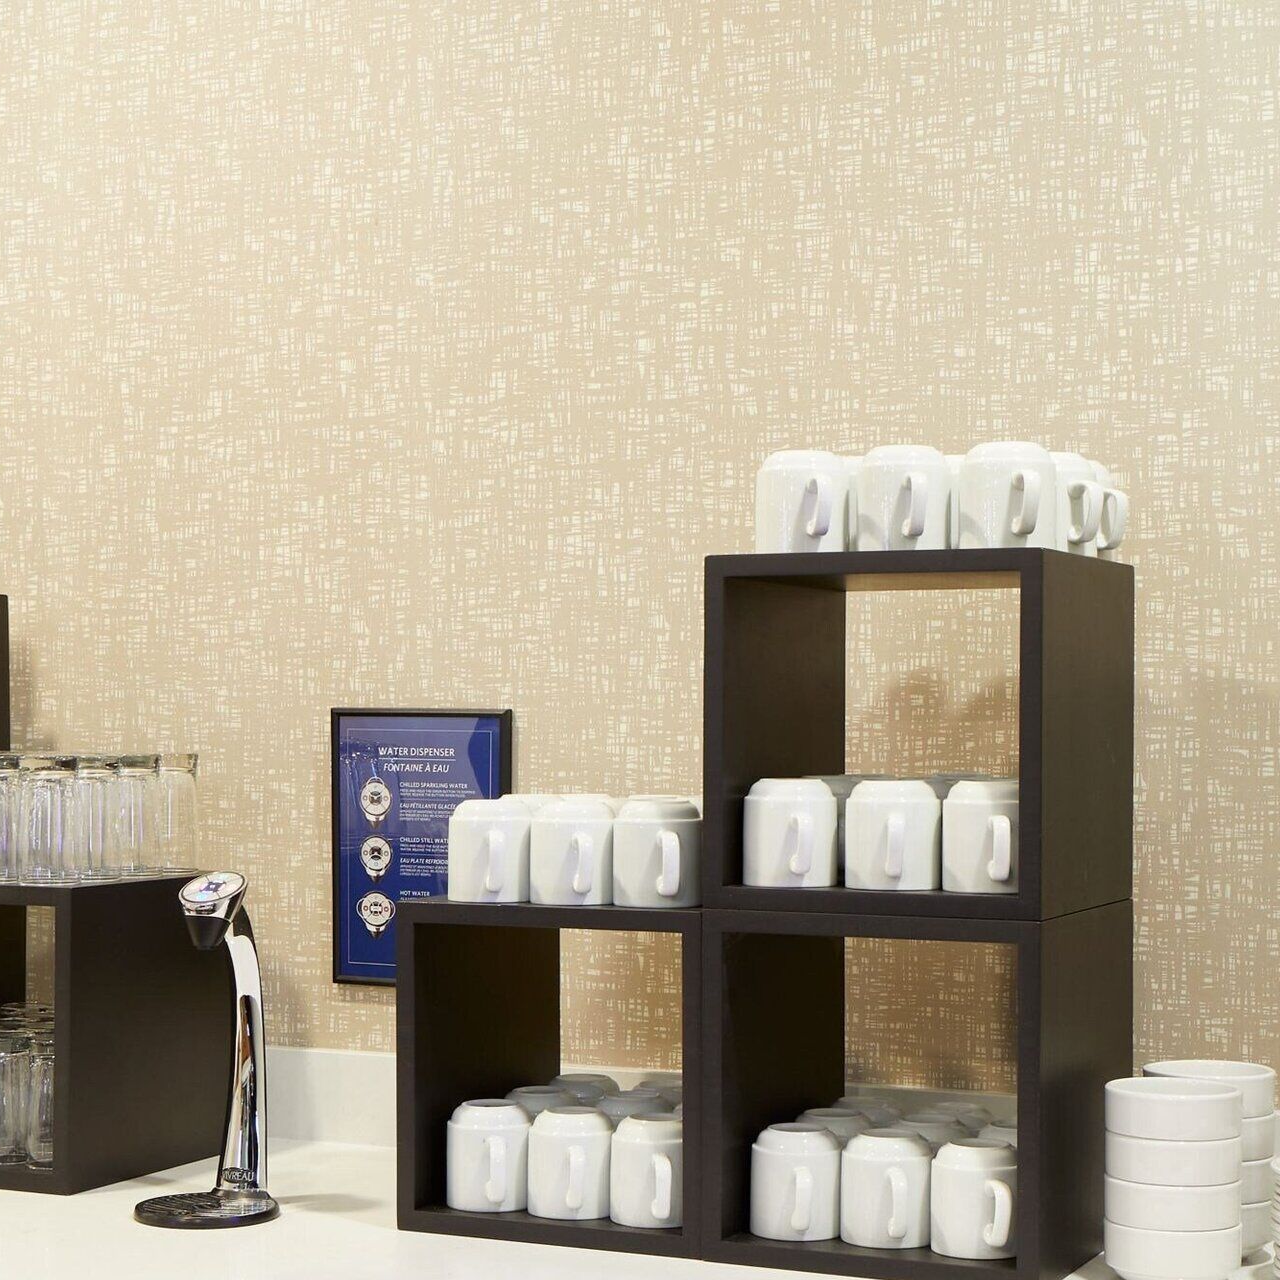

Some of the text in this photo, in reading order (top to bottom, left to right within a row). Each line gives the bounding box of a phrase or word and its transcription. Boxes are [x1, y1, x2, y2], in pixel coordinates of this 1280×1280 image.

[378, 747, 455, 757] WATER DISPENSER
[383, 762, 450, 773] FONTAINE À EAU
